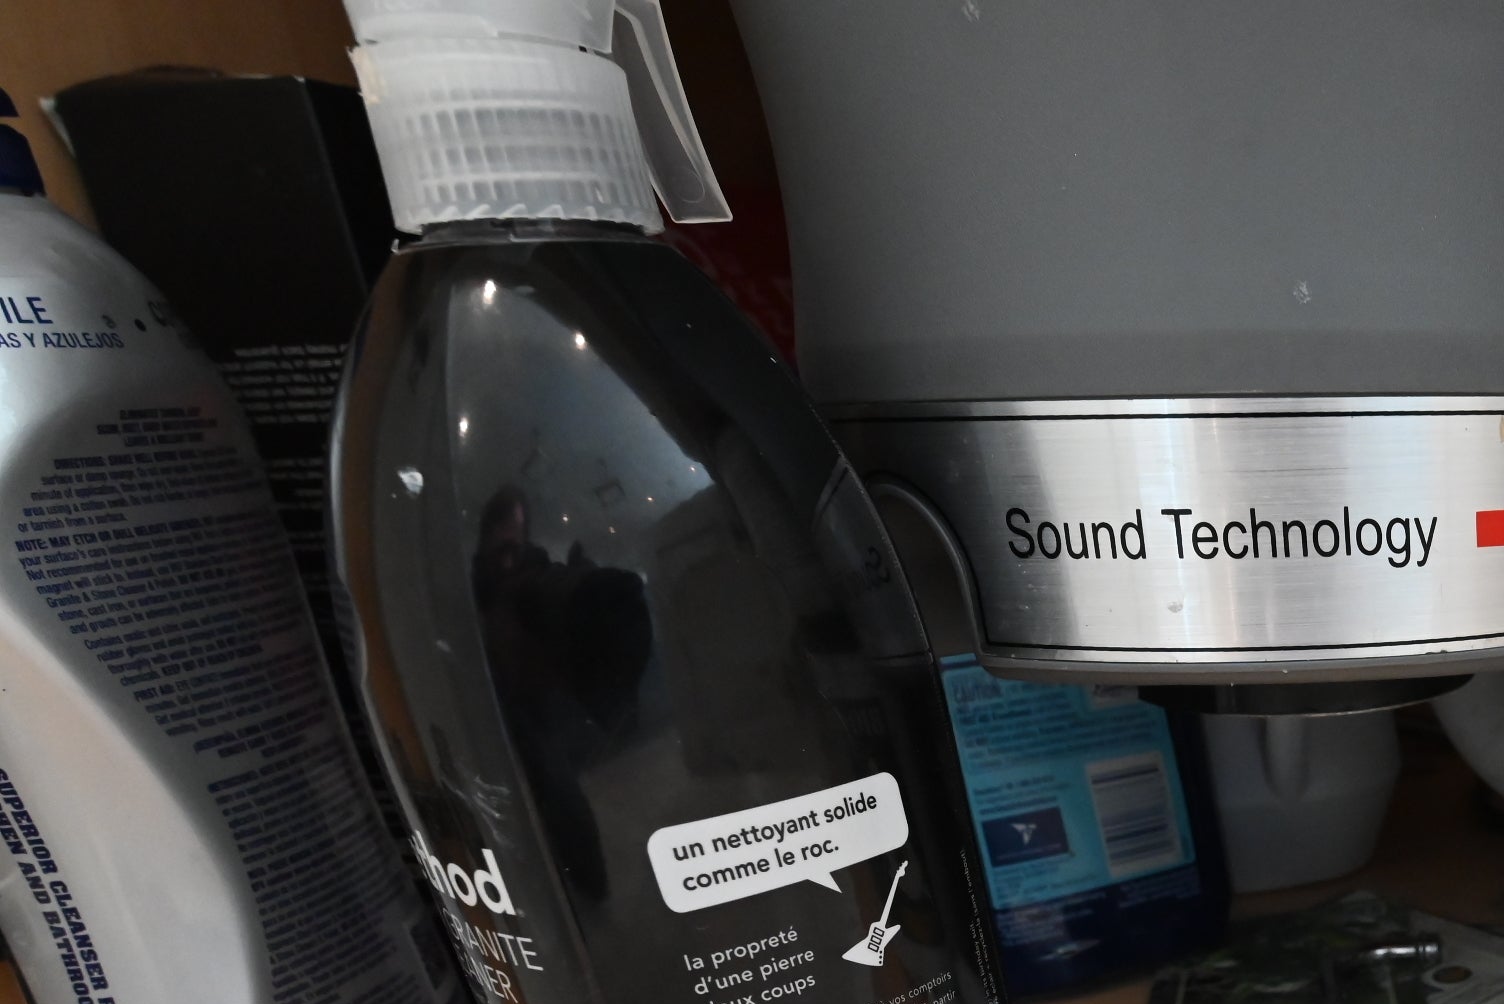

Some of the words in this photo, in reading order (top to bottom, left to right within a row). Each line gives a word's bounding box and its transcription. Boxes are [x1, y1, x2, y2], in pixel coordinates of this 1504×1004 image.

[43, 333, 124, 349] AZULEJOS
[1005, 507, 1145, 561] Sound
[1160, 507, 1438, 568] Technology
[673, 842, 704, 861] un
[712, 811, 819, 853] nettoyant
[824, 792, 877, 823] solide
[0, 768, 58, 874] SUPERIOR
[50, 880, 108, 990] CLEANSER
[18, 861, 52, 904] AND
[683, 858, 770, 891] comme
[774, 848, 795, 867] le
[801, 839, 839, 861] roc.
[684, 955, 704, 971] la
[711, 926, 798, 969] propreté
[760, 951, 815, 981] pierre
[761, 975, 815, 1002] coups
[908, 971, 952, 1000] comptoirs
